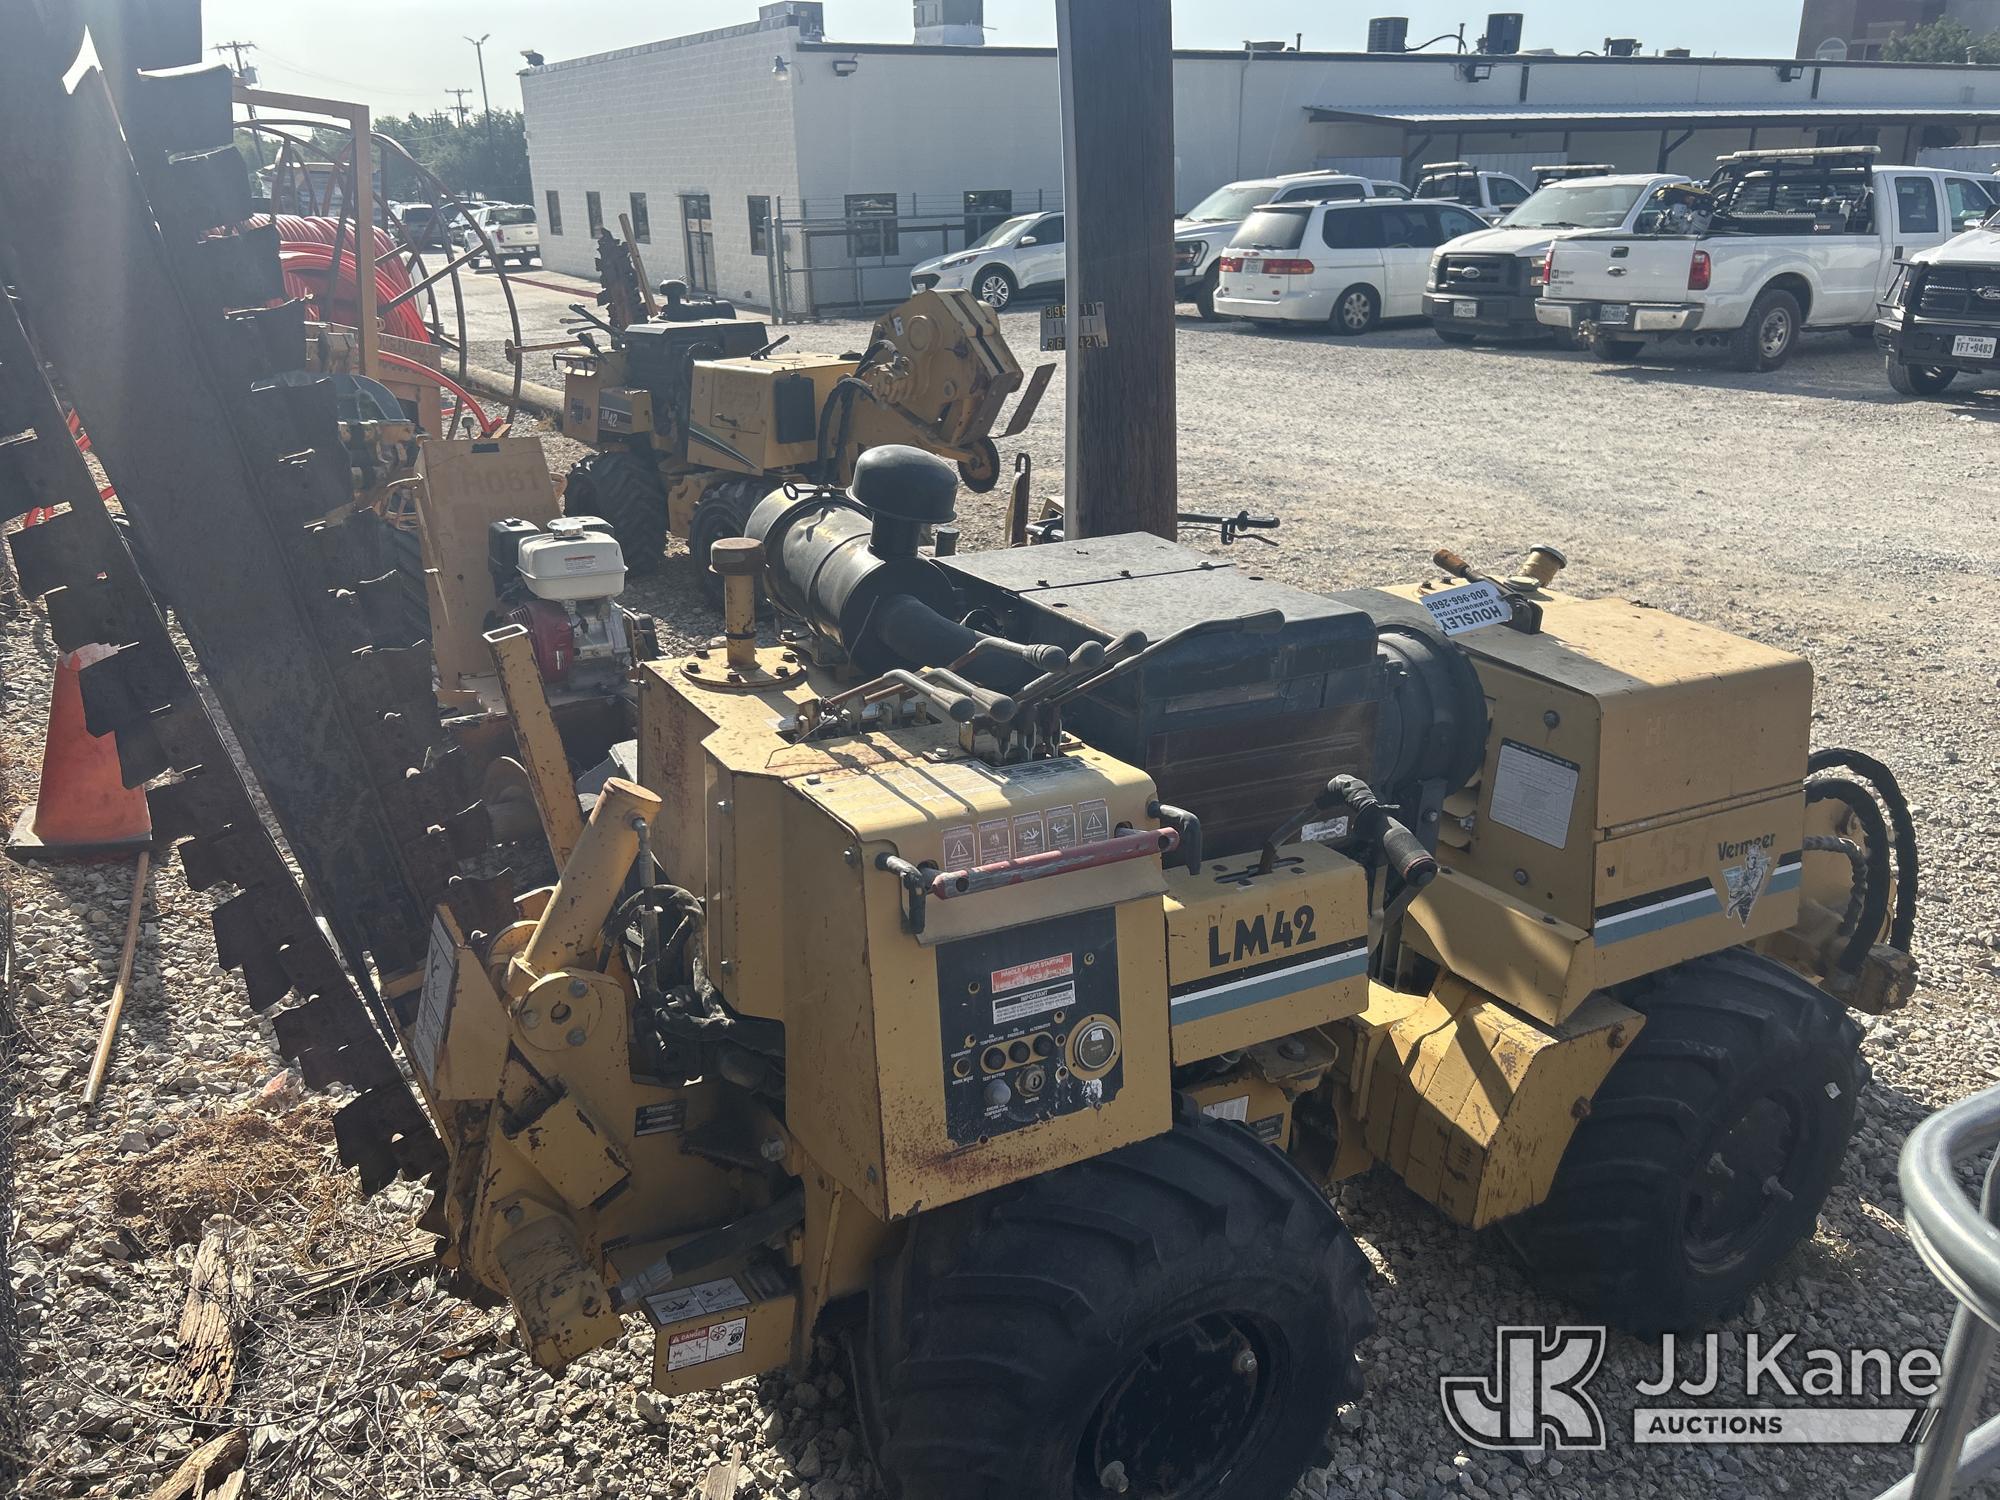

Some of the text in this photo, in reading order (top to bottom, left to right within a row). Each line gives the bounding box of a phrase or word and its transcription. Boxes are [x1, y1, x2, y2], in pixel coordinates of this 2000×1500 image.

[1433, 599, 1494, 619] COMMUNICATIONS
[1440, 605, 1502, 631] HOUSLEY
[1717, 833, 1776, 861] Vermeer
[1208, 905, 1317, 968] LM42
[1020, 990, 1048, 1001] IMPORTANT
